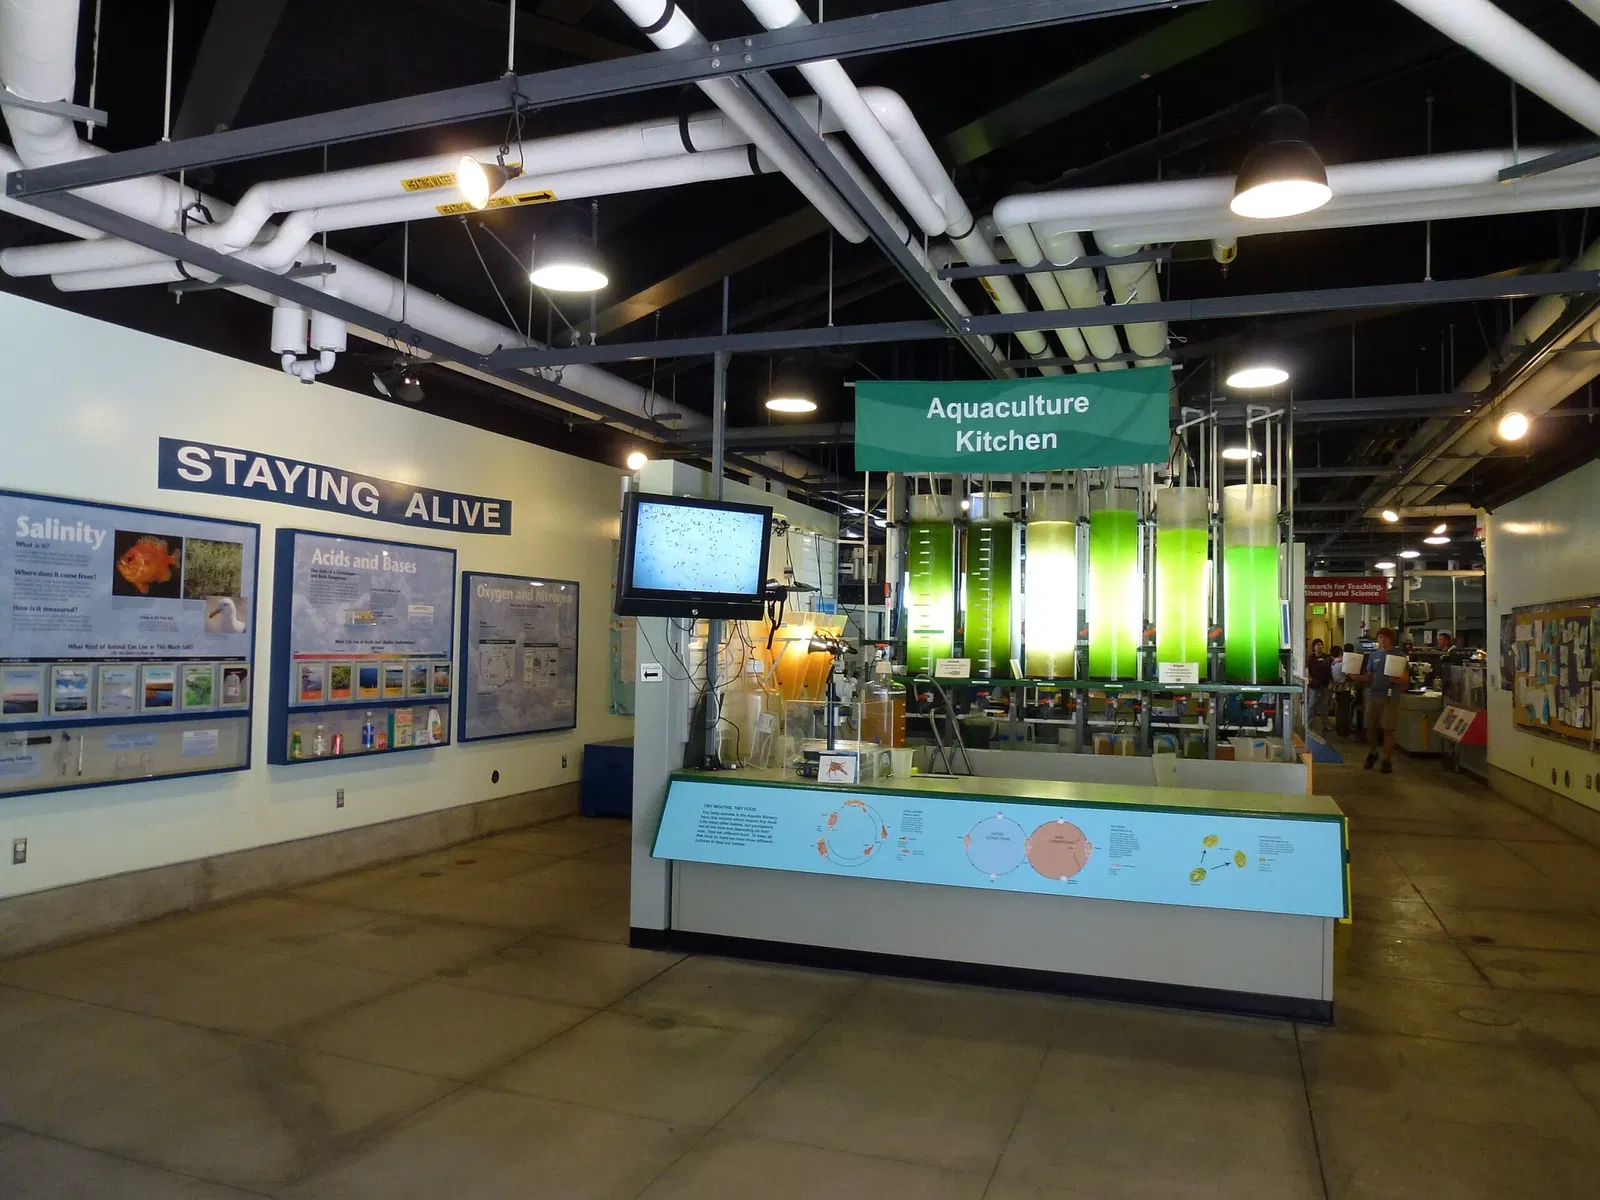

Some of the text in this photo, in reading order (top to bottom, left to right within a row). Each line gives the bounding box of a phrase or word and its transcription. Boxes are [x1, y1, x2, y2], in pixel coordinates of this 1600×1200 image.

[407, 177, 434, 190] HEATING
[433, 174, 452, 187] WATER
[442, 203, 466, 213] HEATING
[926, 394, 1090, 424] Aquaculture
[956, 429, 1058, 452] Kitchen
[176, 446, 501, 528] STAYING ALIVE
[16, 515, 107, 550] Salinity
[16, 541, 33, 549] What
[312, 548, 417, 573] Acids and Bases
[78, 572, 97, 581] from?
[477, 584, 573, 605] Oxygen and Nitrogen
[1305, 590, 1333, 598] Sharing
[1347, 583, 1384, 591] Teaching,
